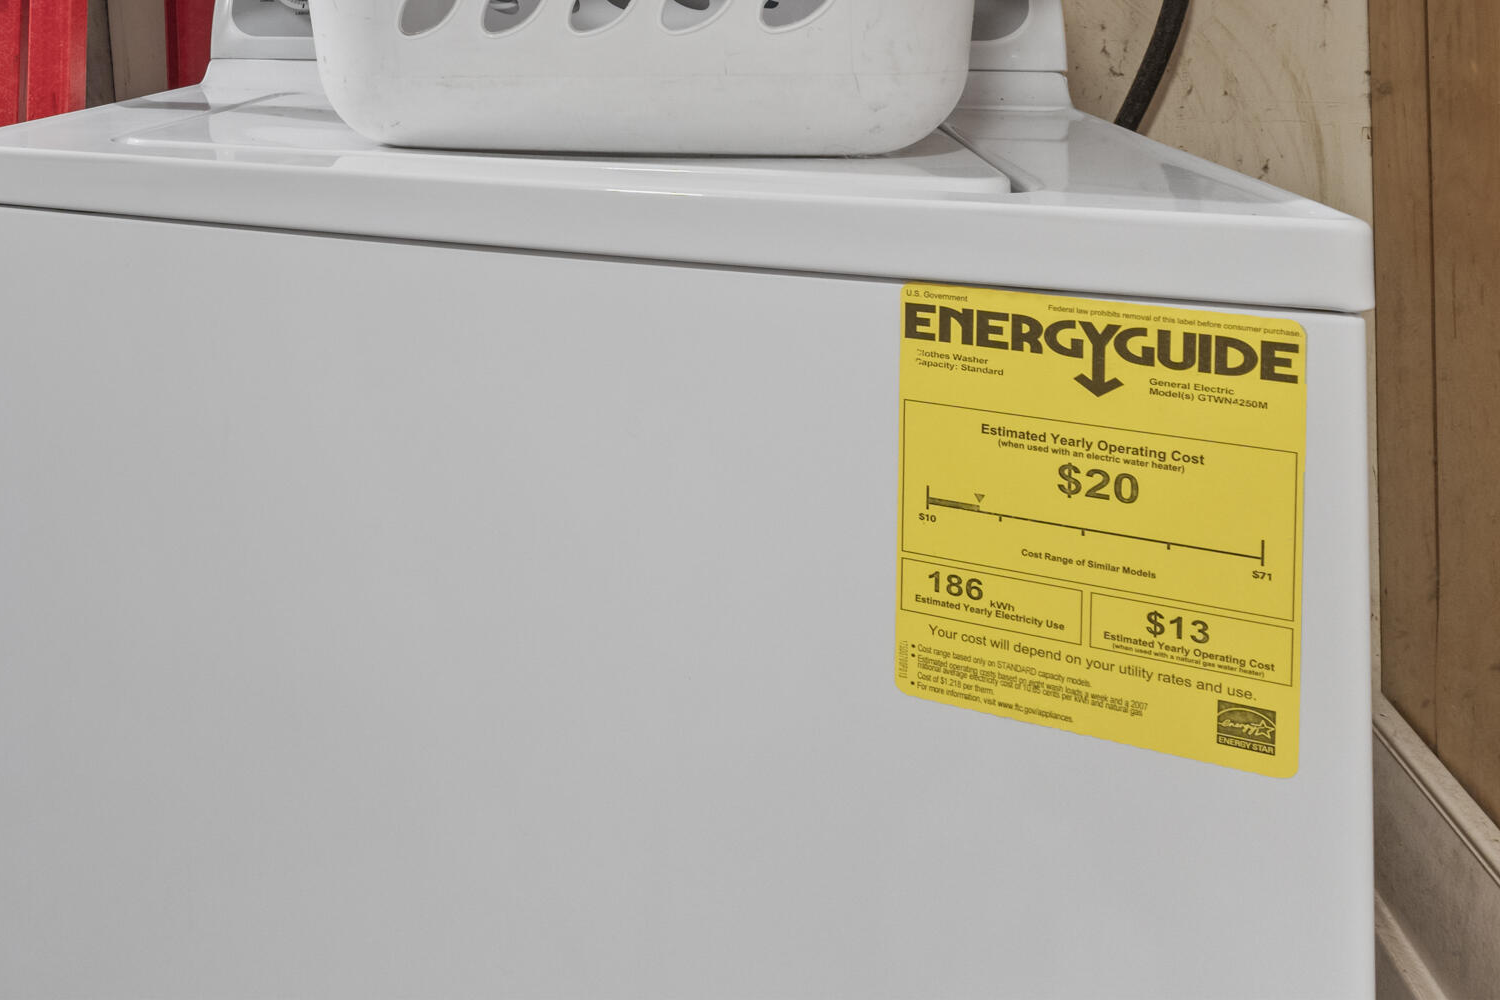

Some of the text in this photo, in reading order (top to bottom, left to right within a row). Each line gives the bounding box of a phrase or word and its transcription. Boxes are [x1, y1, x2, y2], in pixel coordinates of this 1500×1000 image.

[906, 289, 968, 303] U.S. Government
[1048, 304, 1074, 313] Federal
[1090, 310, 1120, 318] prohibits
[1122, 313, 1151, 321] removal
[1197, 320, 1221, 328] before
[1223, 324, 1261, 332] consumer
[904, 302, 1299, 384] ENERGYGUIDE
[952, 353, 988, 364] Washer
[961, 363, 1003, 375] Standard
[1149, 378, 1234, 395] General Electric
[1149, 387, 1194, 401] Model(s)
[981, 423, 1204, 465] Estimated Yearly Operating Cost
[998, 438, 1024, 449] (when
[1027, 444, 1048, 453] used
[1051, 447, 1070, 456] with
[1086, 451, 1120, 463] electric
[1123, 458, 1149, 467] water
[1151, 461, 1184, 474] heater)
[1057, 462, 1139, 504] $20
[918, 512, 936, 522] $10
[1021, 548, 1042, 559] Cost
[1044, 552, 1073, 565] Range
[1087, 560, 1120, 572] Similar
[1122, 566, 1156, 579] Models
[1252, 570, 1271, 581] $71
[928, 571, 983, 600] 186
[915, 594, 1064, 630] Estimated Yearly Electricity Use
[990, 600, 1014, 611] kWh
[1146, 610, 1209, 643] $13
[917, 643, 932, 654] Cost
[933, 649, 950, 658] range
[952, 651, 971, 662] based
[972, 657, 985, 666] only
[997, 660, 1036, 676] STANDARD
[1037, 670, 1065, 683] capacity
[928, 624, 1256, 700] Your cost will depend on your utility rates and use.
[1103, 631, 1275, 672] Estimated Yearly Operating Cost
[1218, 736, 1273, 754] ENERGY STAR
